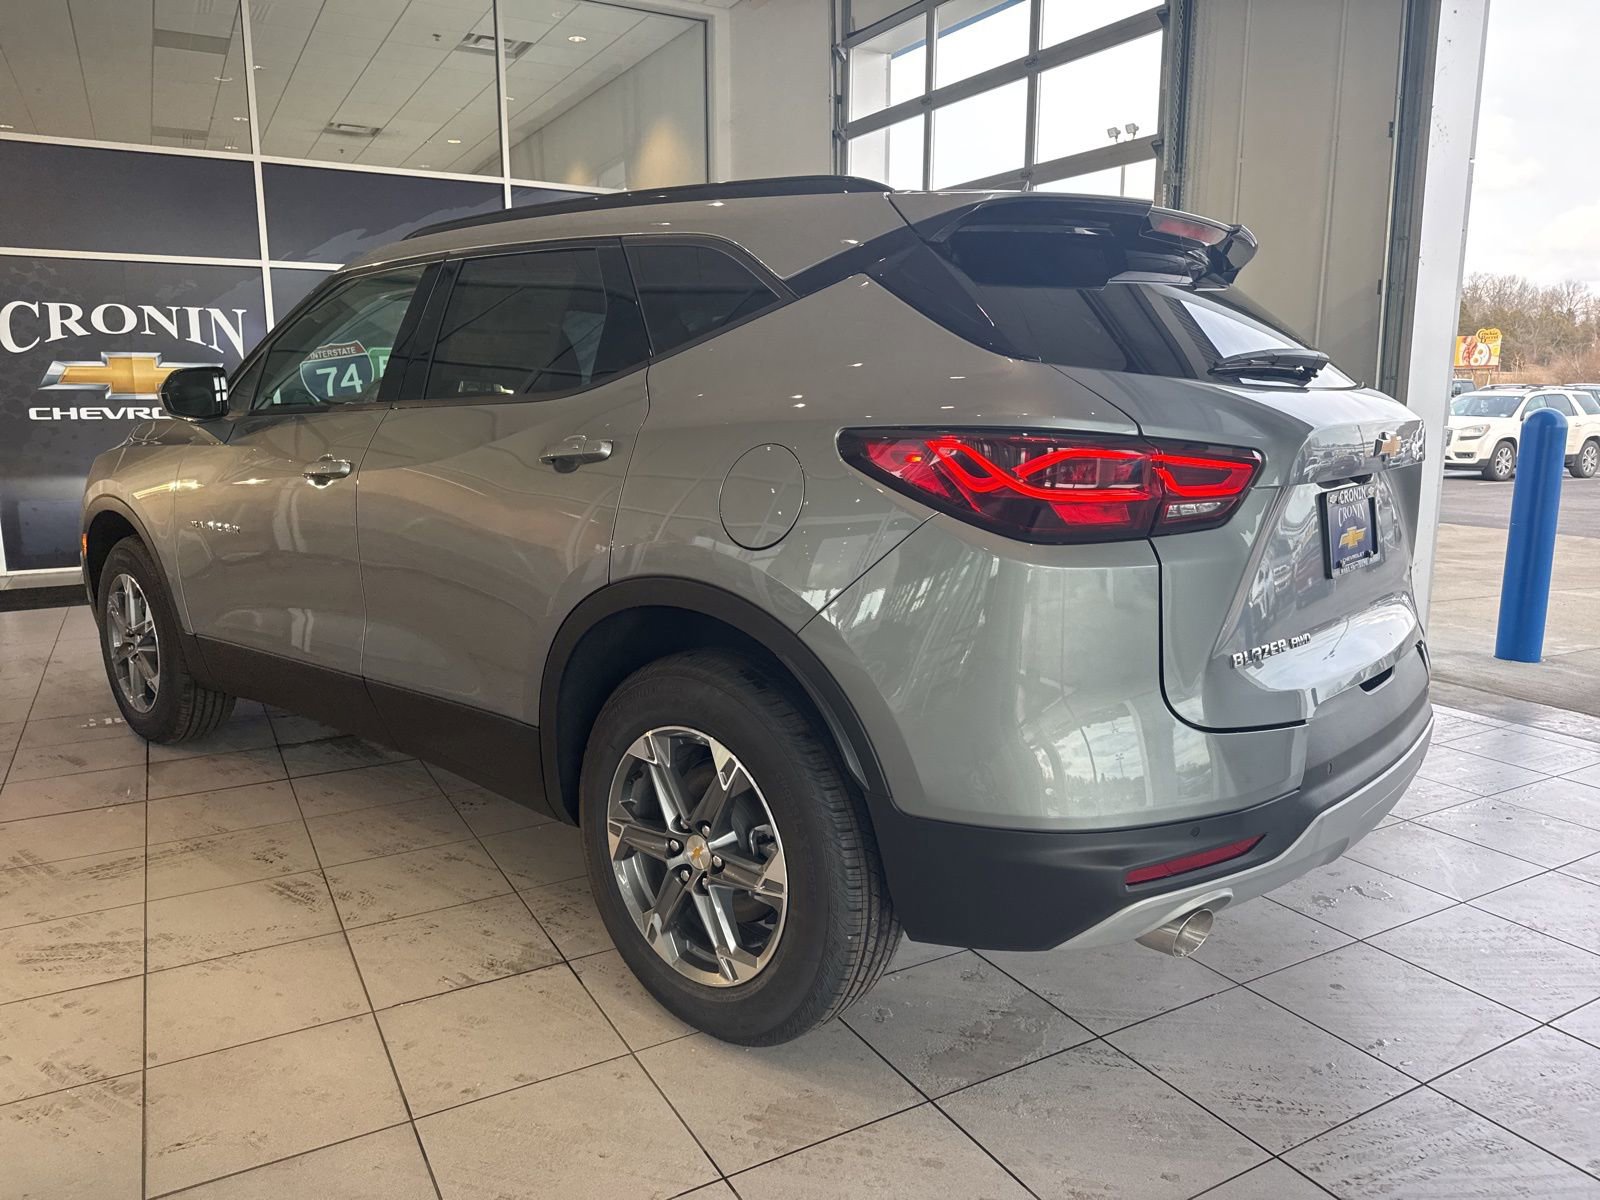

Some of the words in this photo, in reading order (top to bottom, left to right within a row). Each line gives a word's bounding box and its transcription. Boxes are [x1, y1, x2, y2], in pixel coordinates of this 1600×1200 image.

[0, 300, 248, 360] CRONIN
[310, 346, 357, 360] INTERSTATE
[315, 363, 363, 397] 74
[28, 407, 173, 420] CHEVRO
[1339, 486, 1367, 505] CRONIN
[1338, 503, 1365, 527] CRONIN
[1231, 638, 1287, 668] BLAZER
